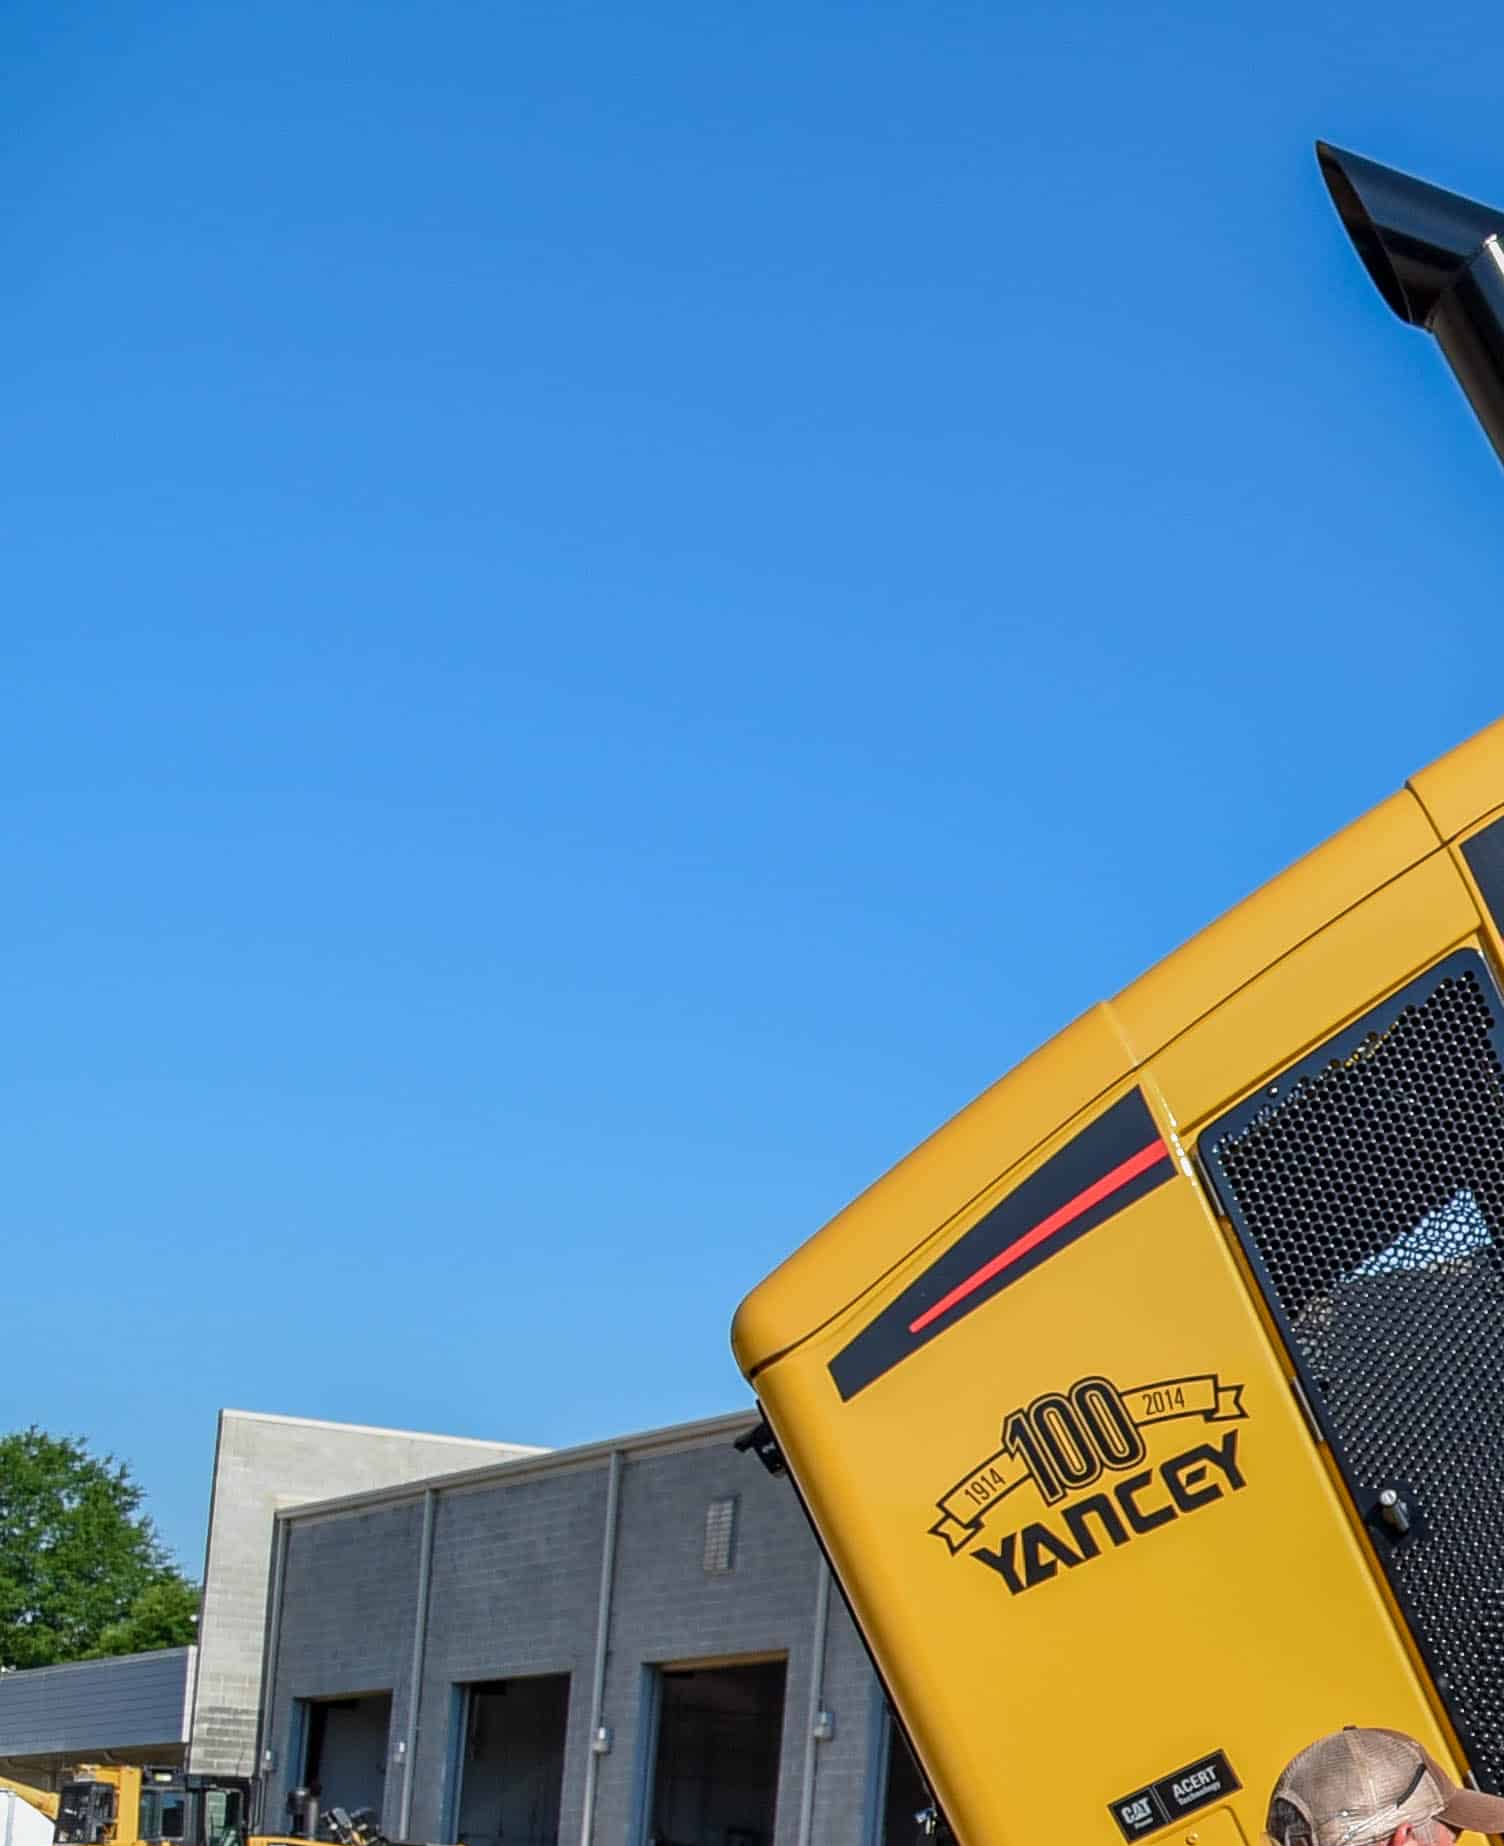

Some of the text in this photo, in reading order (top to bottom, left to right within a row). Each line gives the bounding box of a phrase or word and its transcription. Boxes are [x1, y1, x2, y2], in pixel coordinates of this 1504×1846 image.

[1142, 1386, 1186, 1415] 2014
[1002, 1376, 1147, 1507] 100
[964, 1467, 1007, 1506] 1914
[969, 1428, 1247, 1596] YANCEY
[1172, 1765, 1217, 1799] ACERT
[1121, 1797, 1152, 1825] CAT
